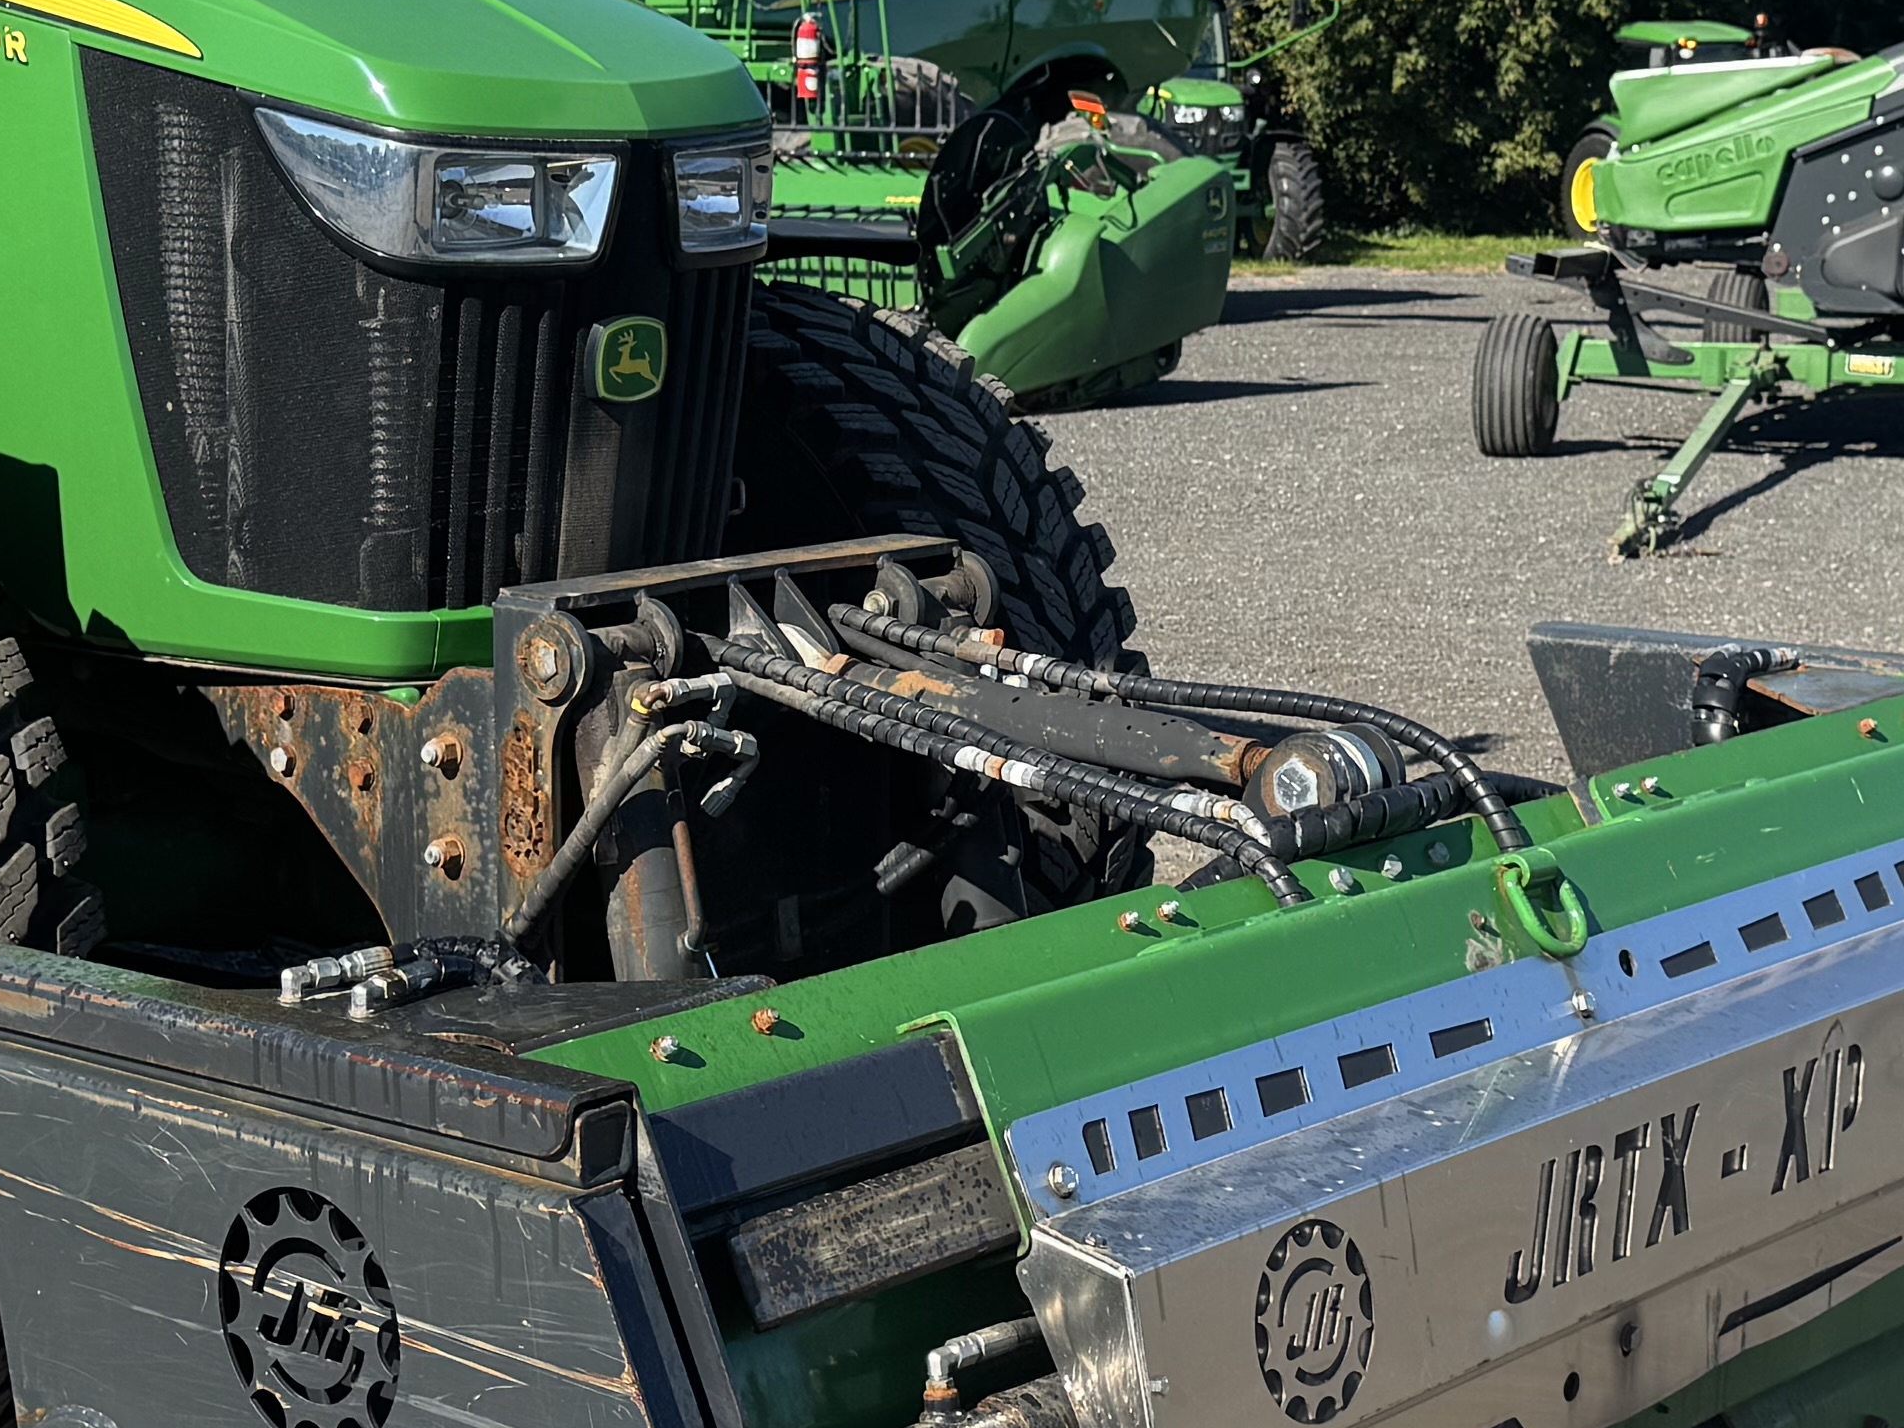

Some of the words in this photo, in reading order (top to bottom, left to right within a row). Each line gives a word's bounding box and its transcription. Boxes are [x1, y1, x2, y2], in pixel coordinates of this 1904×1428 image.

[4, 26, 29, 66] R
[1504, 1103, 1700, 1305] JRTX
[1771, 1043, 1866, 1195] XP
